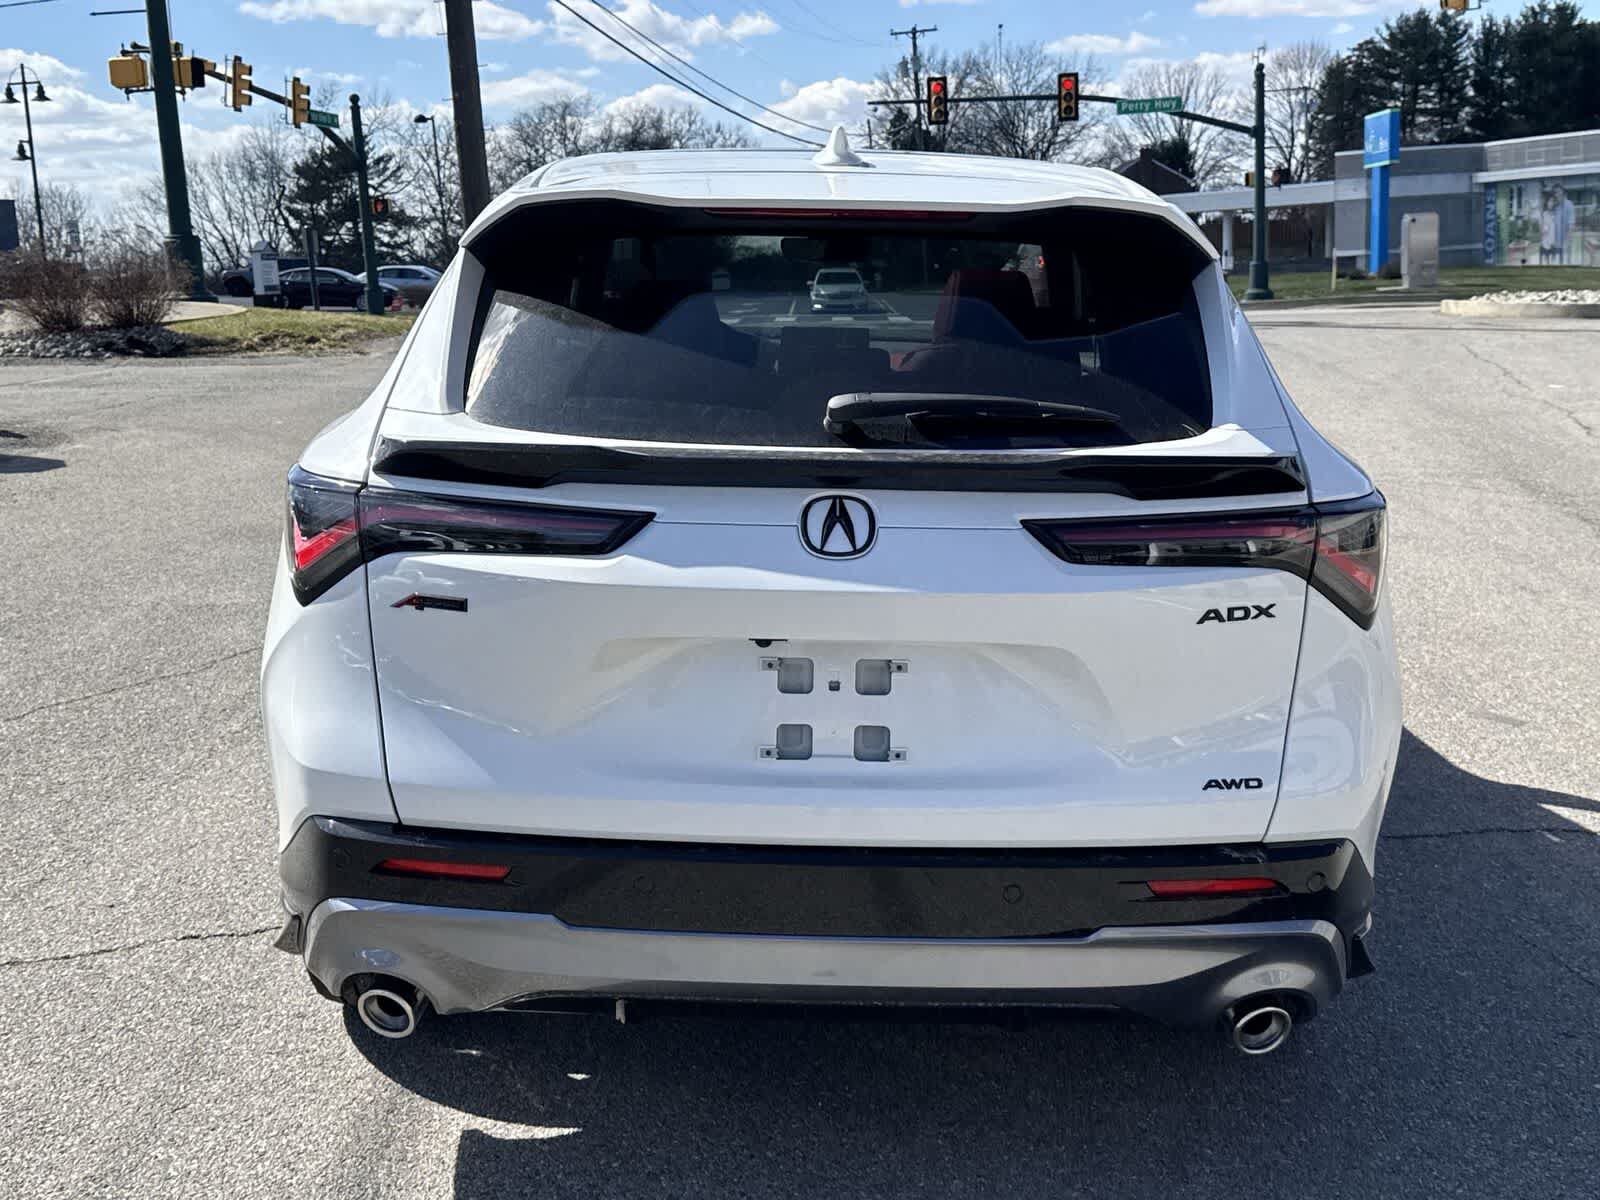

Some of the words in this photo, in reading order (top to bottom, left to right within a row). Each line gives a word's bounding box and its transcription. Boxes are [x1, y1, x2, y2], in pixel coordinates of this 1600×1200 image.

[1121, 101, 1149, 111] Perry
[1154, 99, 1177, 110] Hwy
[1485, 186, 1496, 264] LOANS
[1196, 603, 1277, 624] ADX
[1202, 778, 1263, 791] AWD
